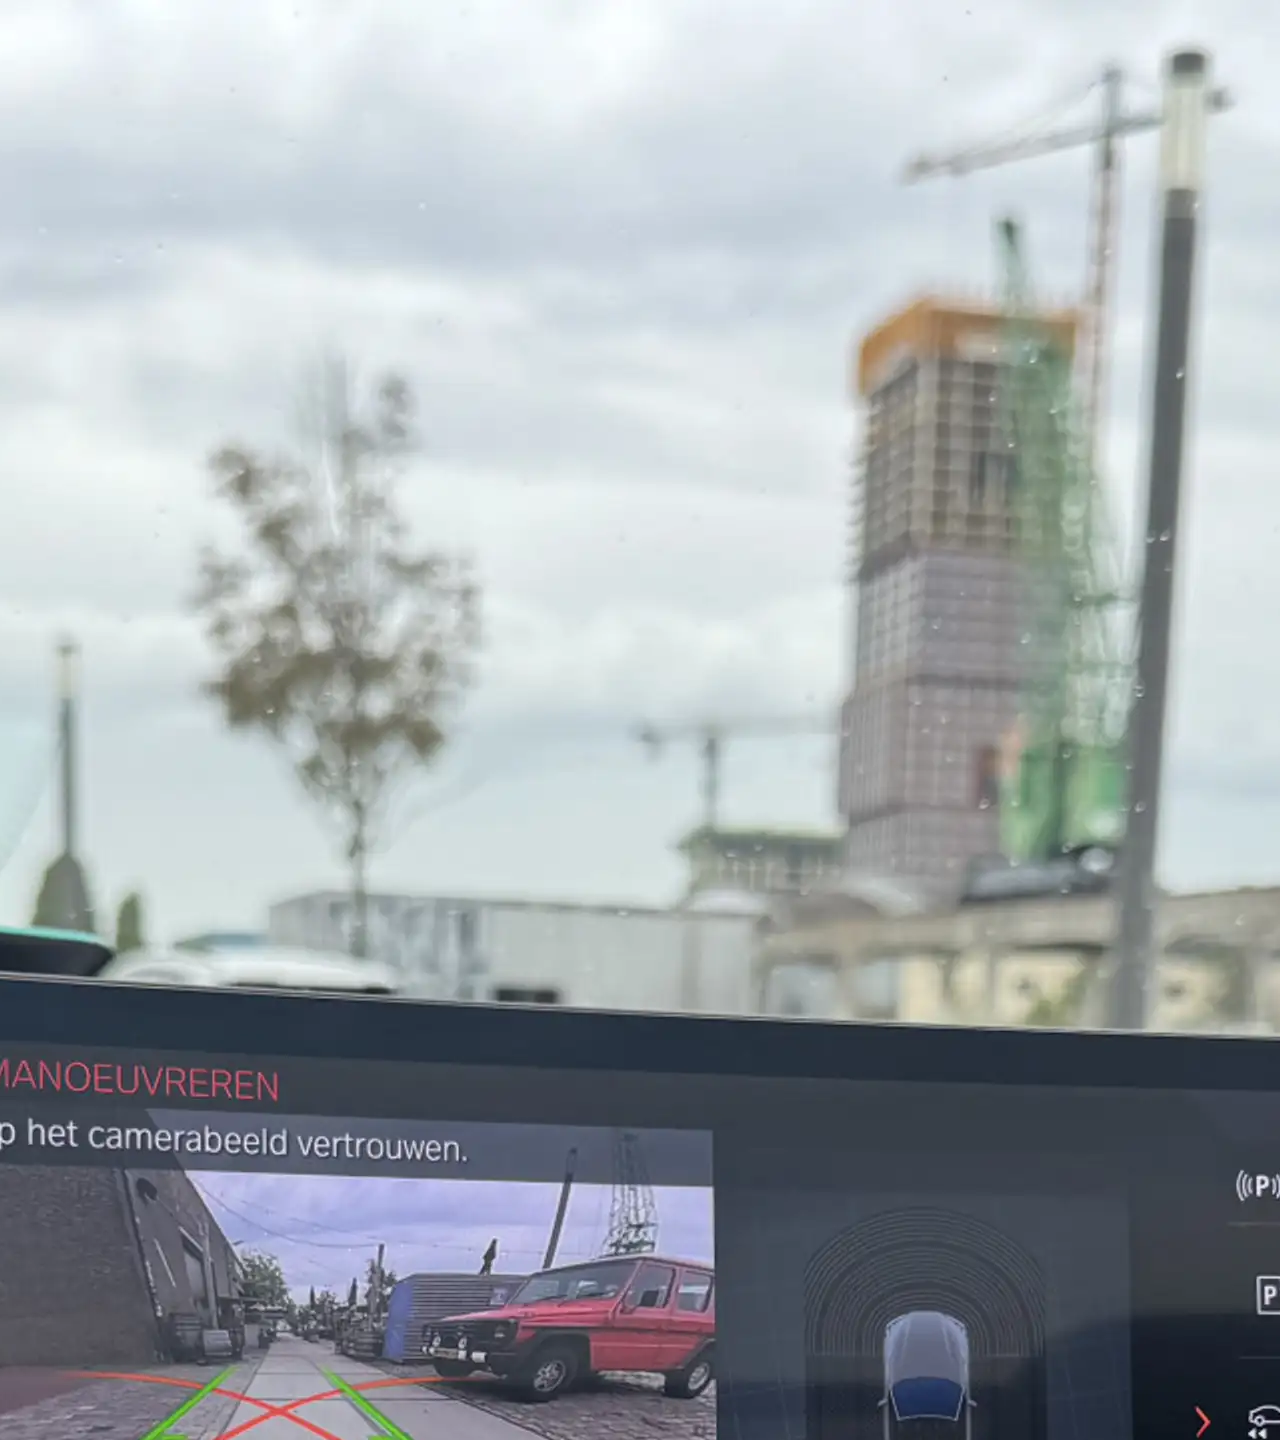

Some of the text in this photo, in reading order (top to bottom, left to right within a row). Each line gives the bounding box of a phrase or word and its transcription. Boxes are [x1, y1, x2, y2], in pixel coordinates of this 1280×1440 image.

[27, 1117, 79, 1148] het
[88, 1121, 288, 1158] camerabeeld
[298, 1135, 469, 1164] vertrouwen.
